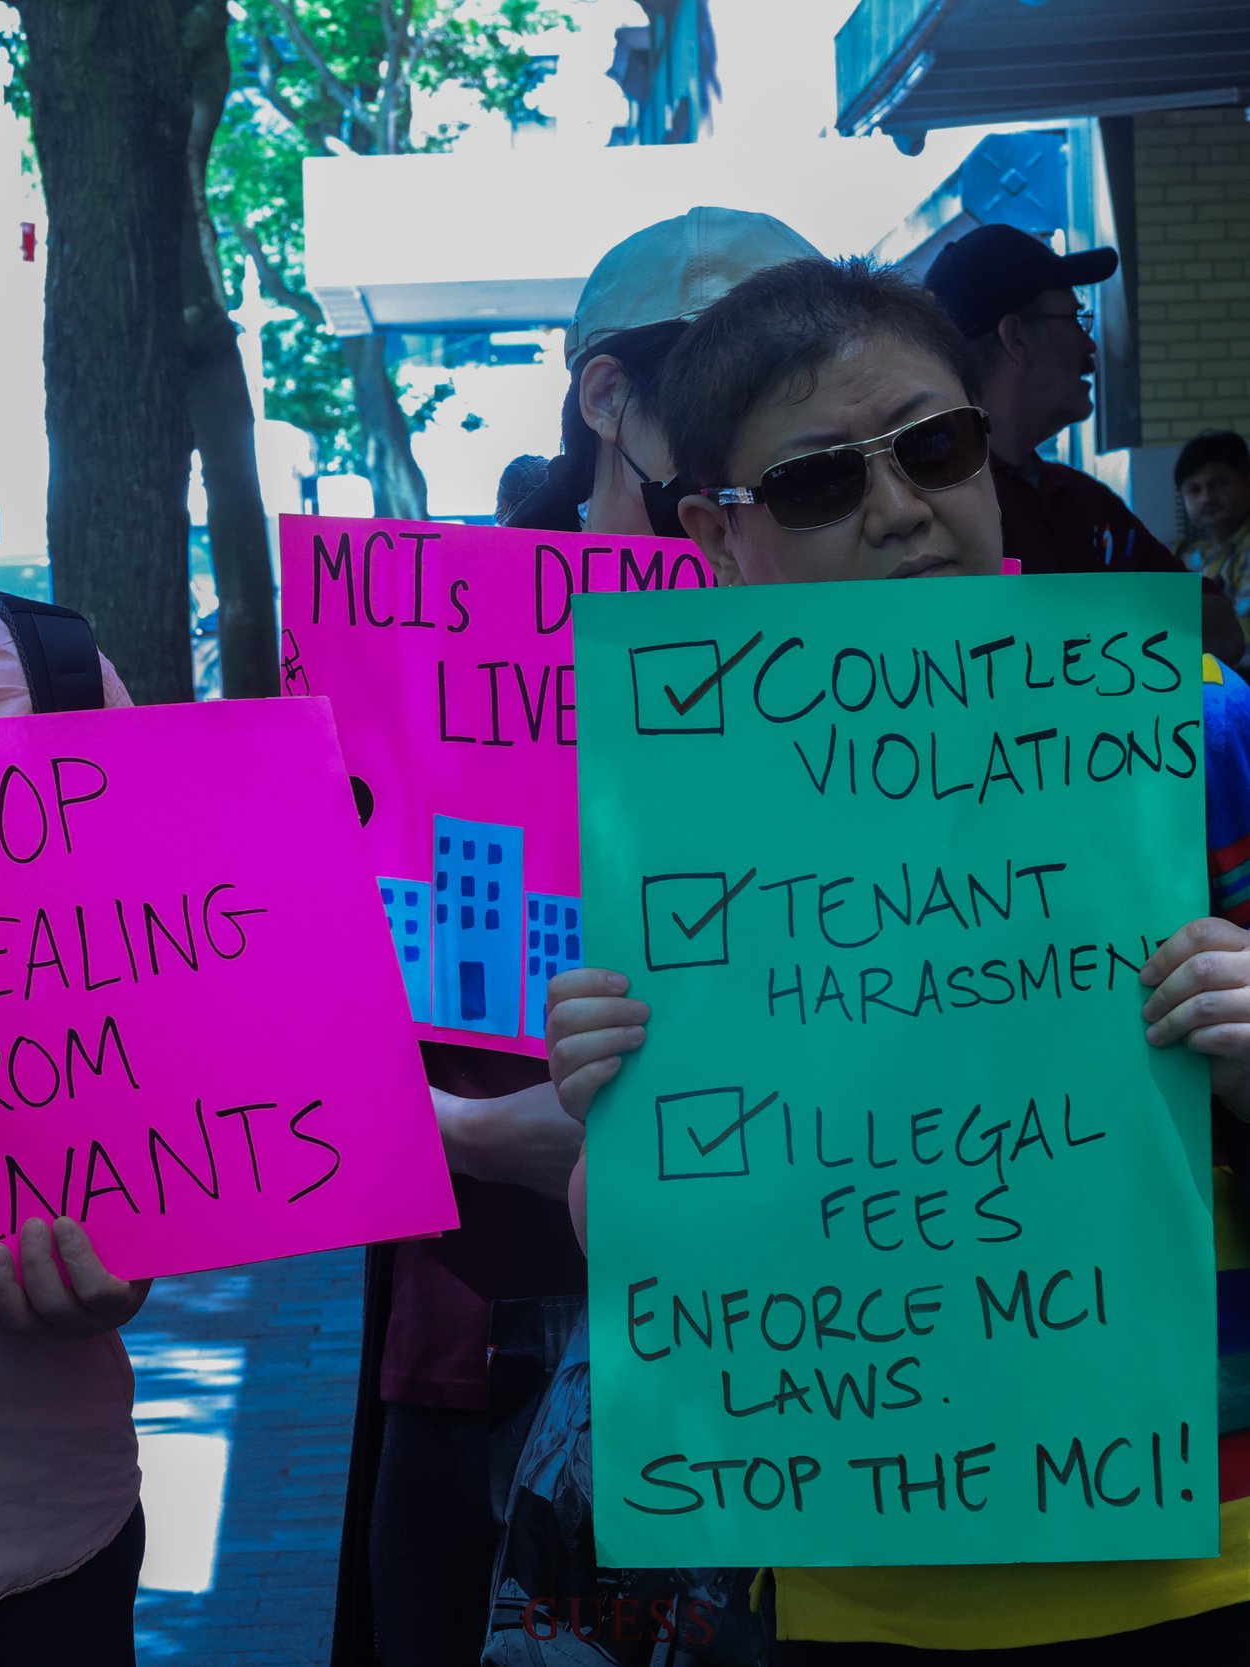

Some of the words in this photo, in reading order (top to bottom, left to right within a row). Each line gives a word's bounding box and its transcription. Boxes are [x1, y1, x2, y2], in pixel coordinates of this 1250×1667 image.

[312, 530, 470, 633] MCIs
[753, 631, 1183, 723] COUNTLESS
[793, 716, 1201, 804] VIOLATIONS
[758, 859, 1067, 949] TENANT
[767, 934, 1170, 1025] HARASSMEN
[783, 1093, 1106, 1184] ILLEGAL
[820, 1185, 1023, 1252] FEES
[628, 1277, 944, 1362] ENFORCE
[975, 1265, 1107, 1340] MCI
[721, 1356, 951, 1421] LAWS.
[623, 1453, 822, 1515] STOP
[849, 1441, 996, 1514] THE
[1036, 1421, 1194, 1514] MCI!
[522, 1595, 716, 1645] GUESS
